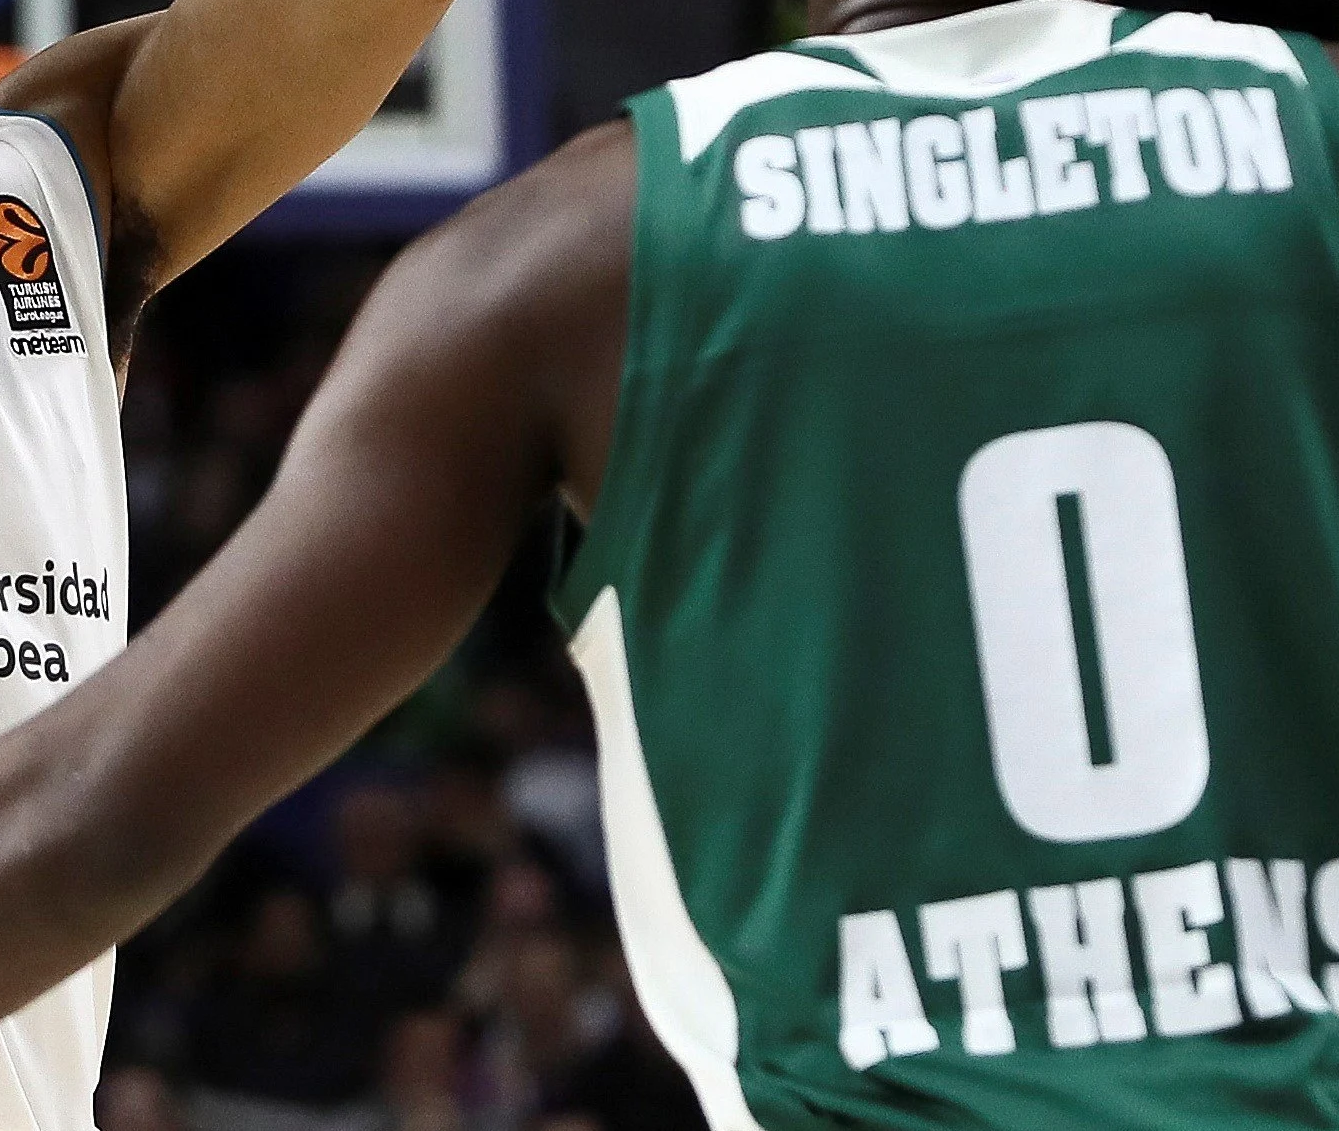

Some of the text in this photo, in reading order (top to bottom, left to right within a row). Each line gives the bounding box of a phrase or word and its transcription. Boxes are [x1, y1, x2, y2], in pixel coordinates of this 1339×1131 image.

[734, 87, 1294, 240] SINGLETON
[8, 282, 58, 296] TURKISH
[13, 296, 61, 310] AIRLINES
[10, 333, 86, 356] oneteam
[958, 420, 1210, 844] 0
